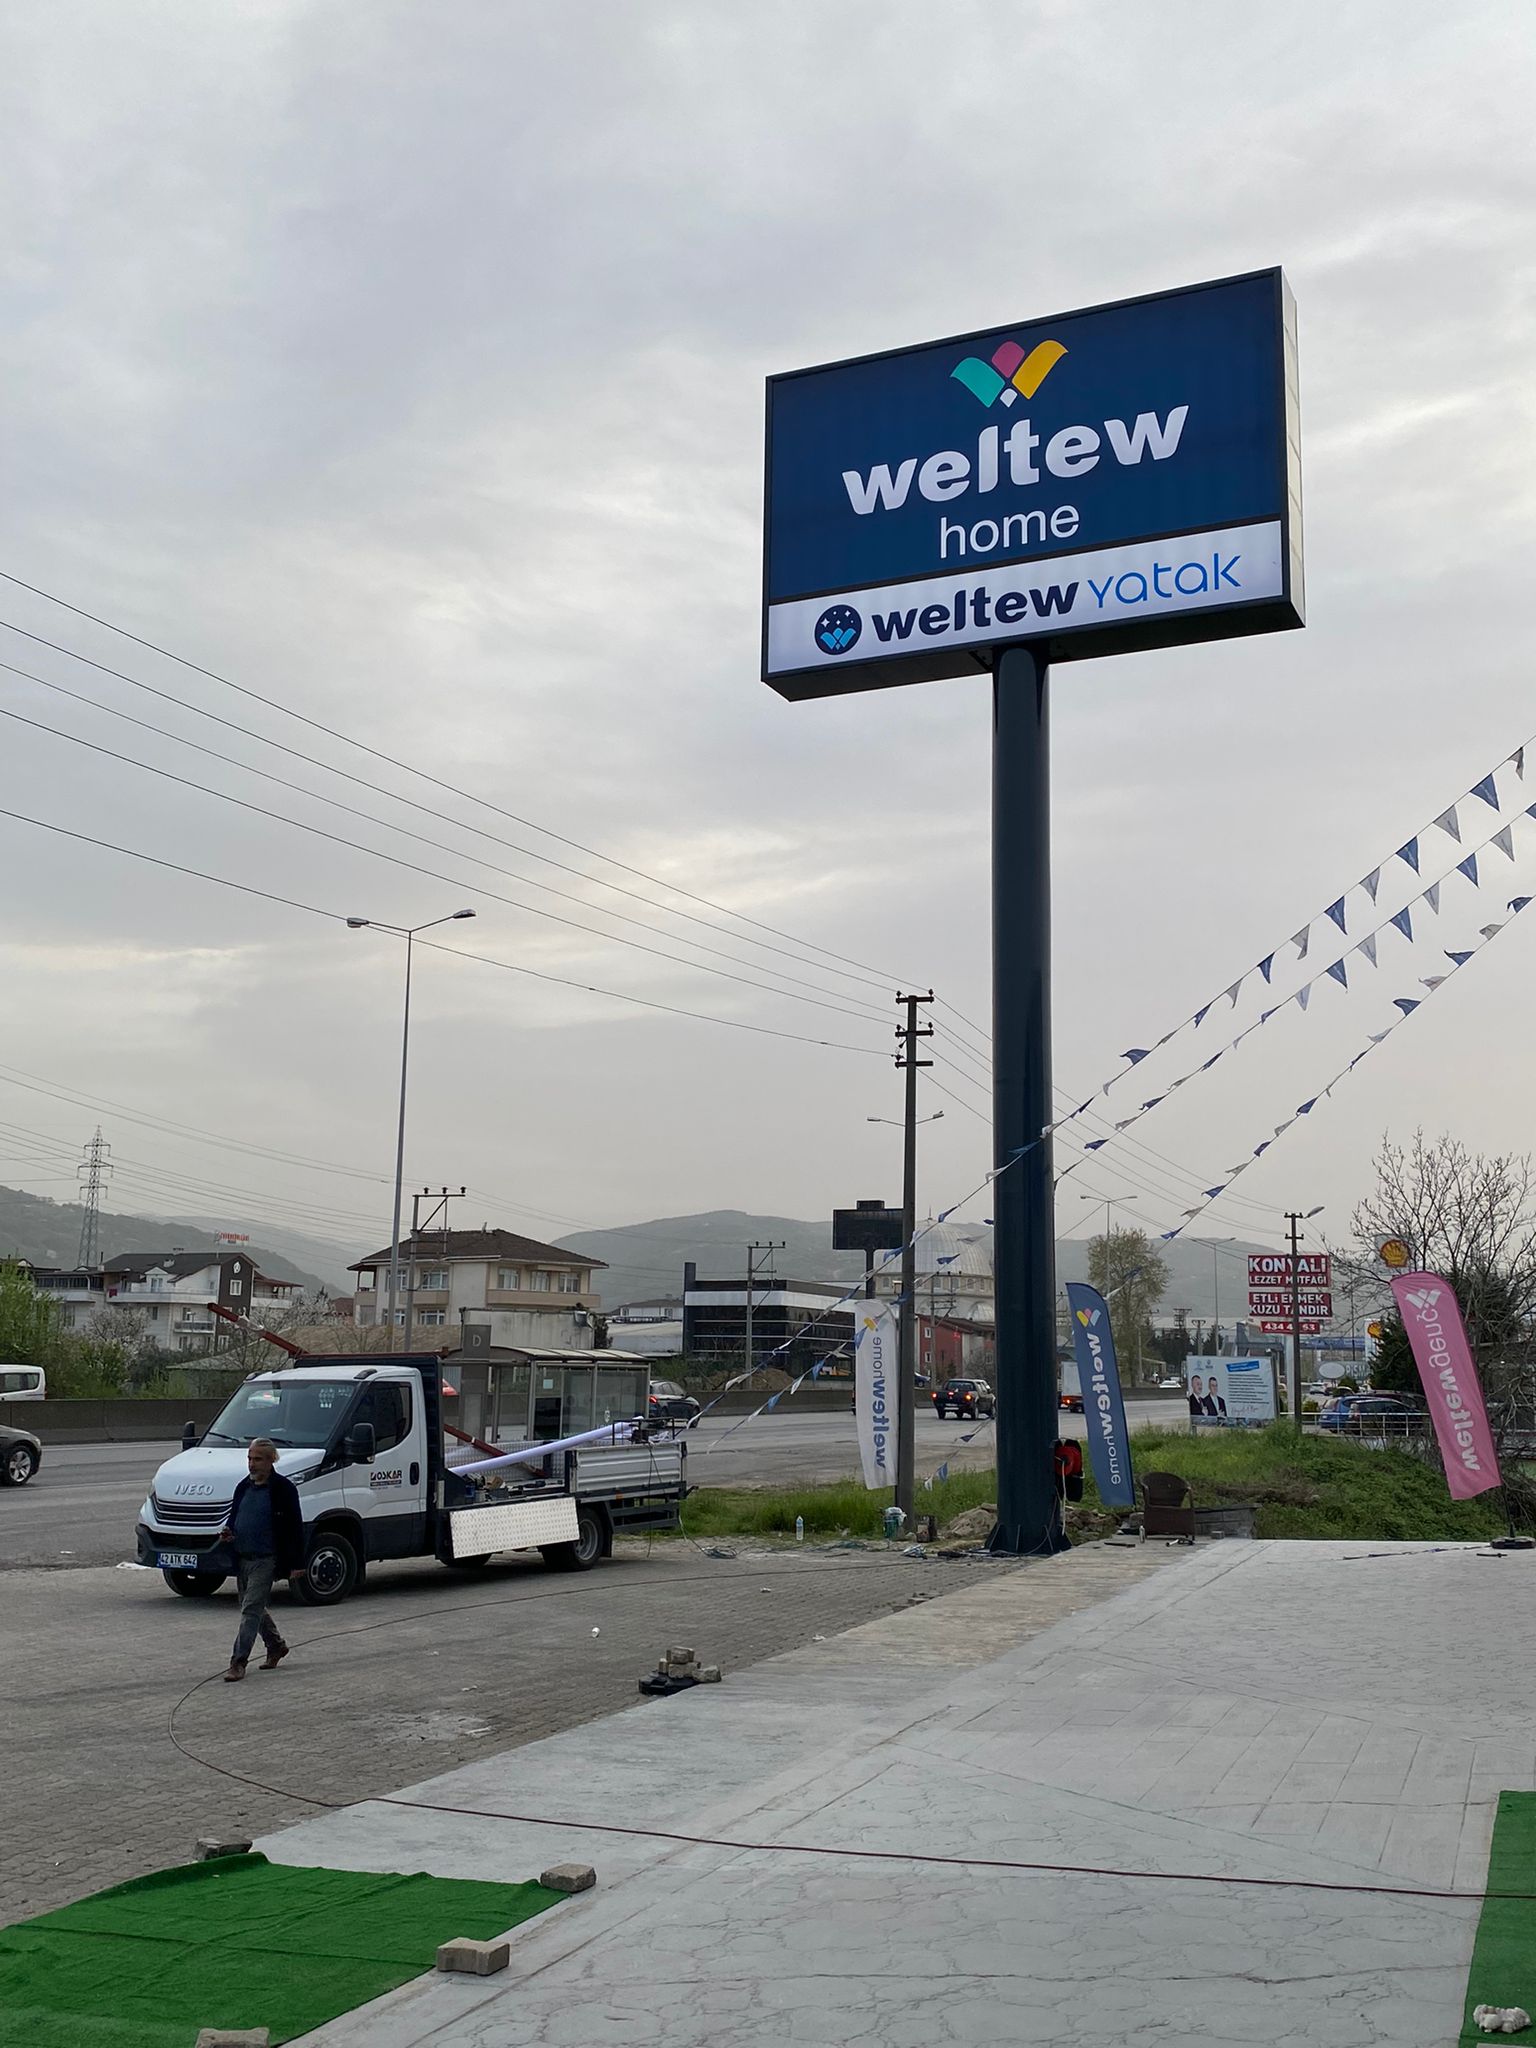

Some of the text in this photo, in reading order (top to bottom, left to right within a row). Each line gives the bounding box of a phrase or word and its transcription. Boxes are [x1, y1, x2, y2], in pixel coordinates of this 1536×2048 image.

[841, 404, 1189, 516] weltew
[940, 504, 1080, 559] home
[872, 552, 1242, 641] weltew yatak
[1249, 1274, 1327, 1284] LEZZET MTFAĞI
[1249, 1304, 1329, 1315] KUZU TNDIR
[472, 1334, 481, 1347] D
[174, 1484, 214, 1496] IVECO
